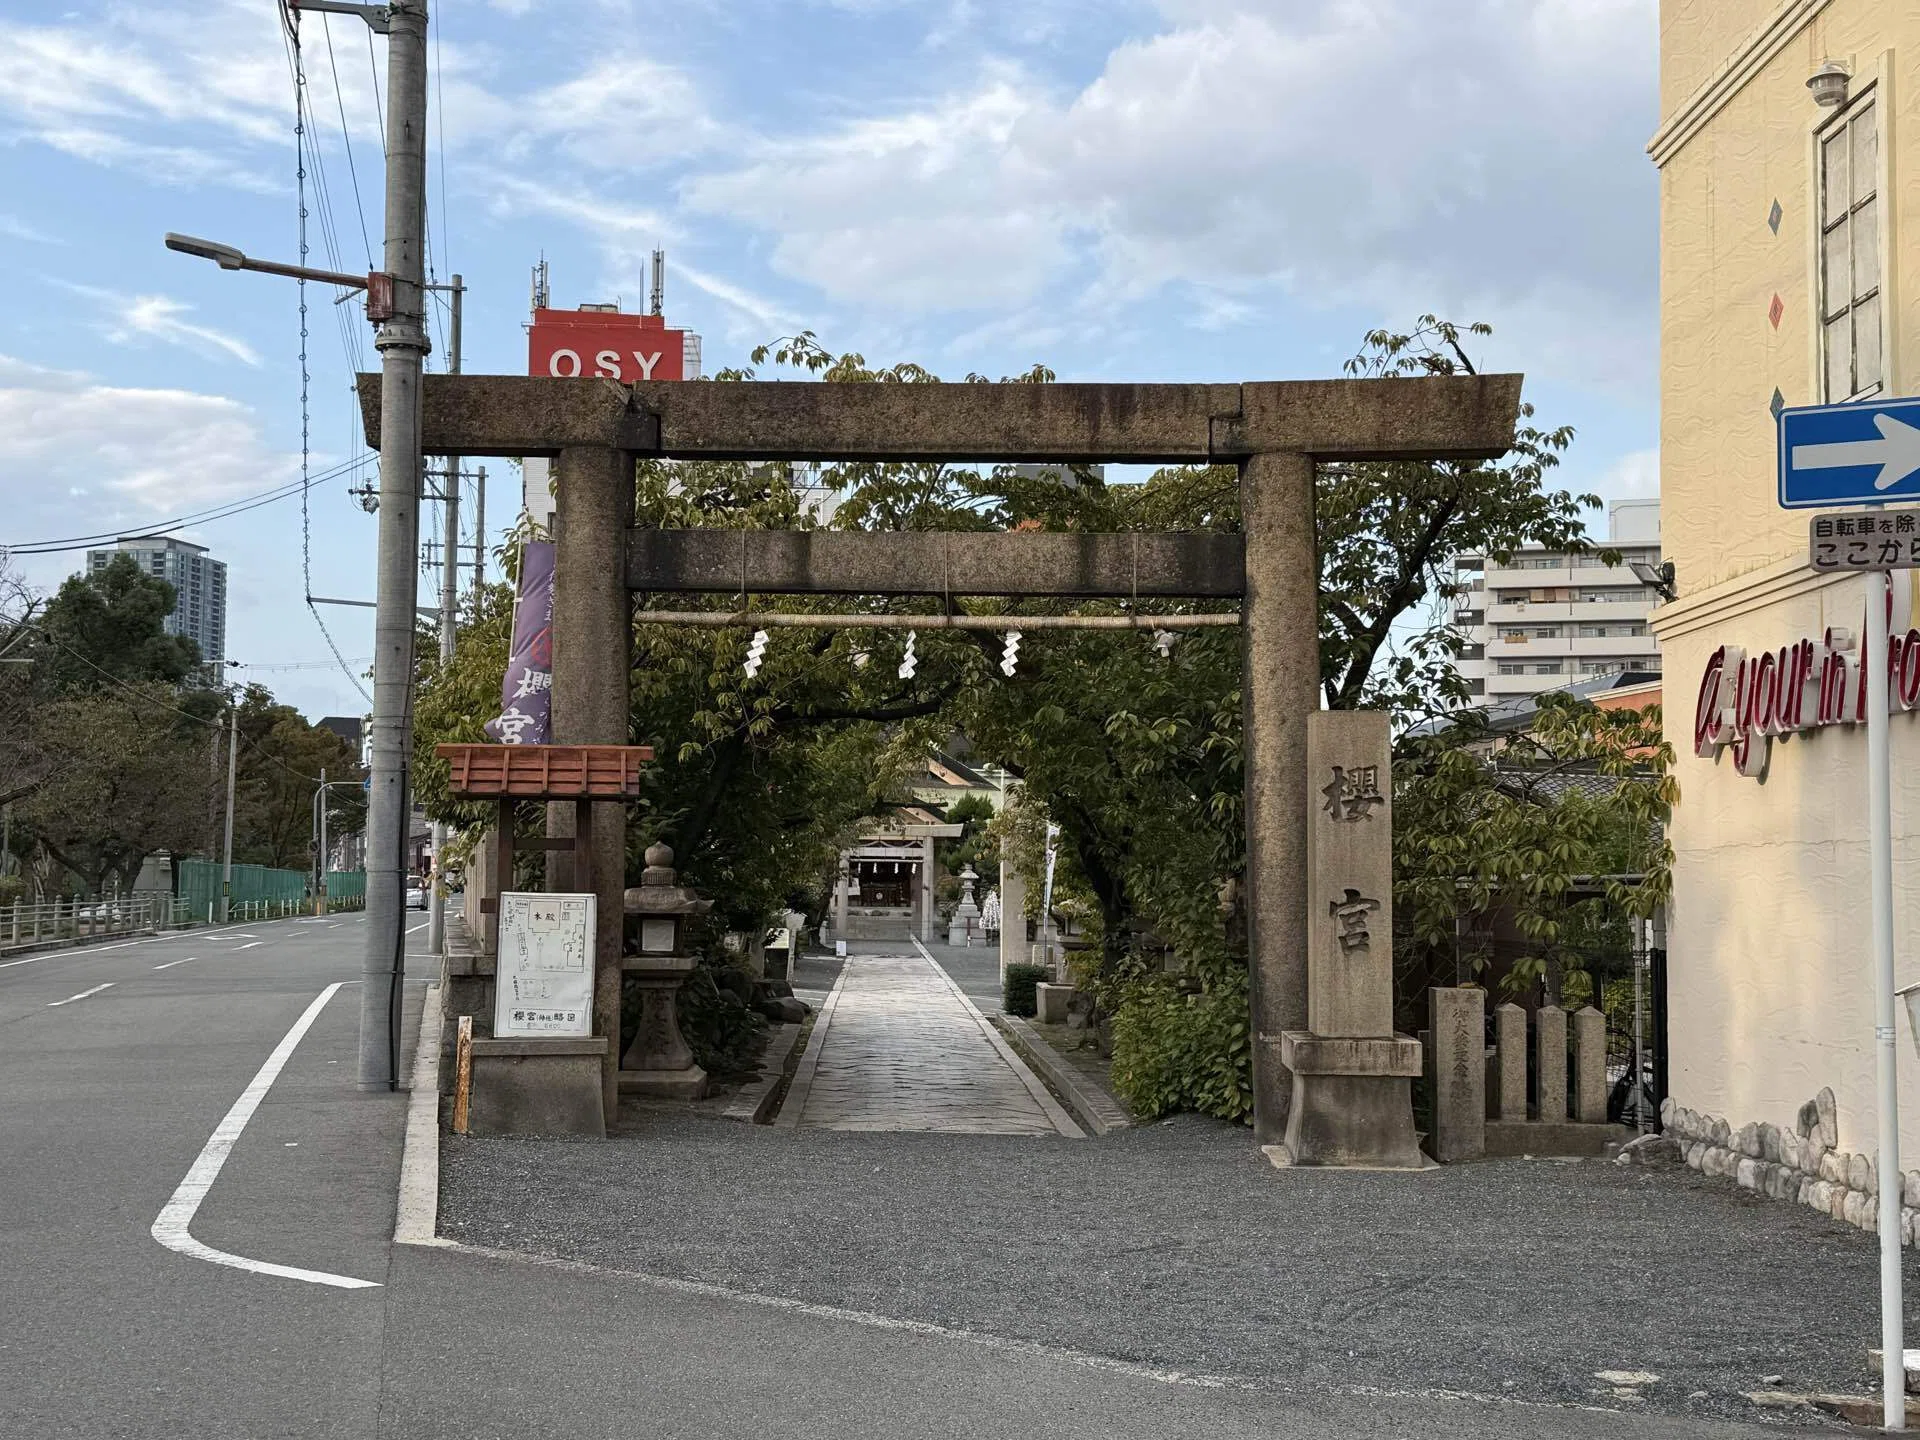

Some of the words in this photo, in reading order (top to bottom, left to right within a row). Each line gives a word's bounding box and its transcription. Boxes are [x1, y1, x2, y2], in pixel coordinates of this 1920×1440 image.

[549, 348, 662, 380] OSY
[1816, 514, 1920, 537] 自転車を除
[1320, 764, 1385, 956] 櫻宮
